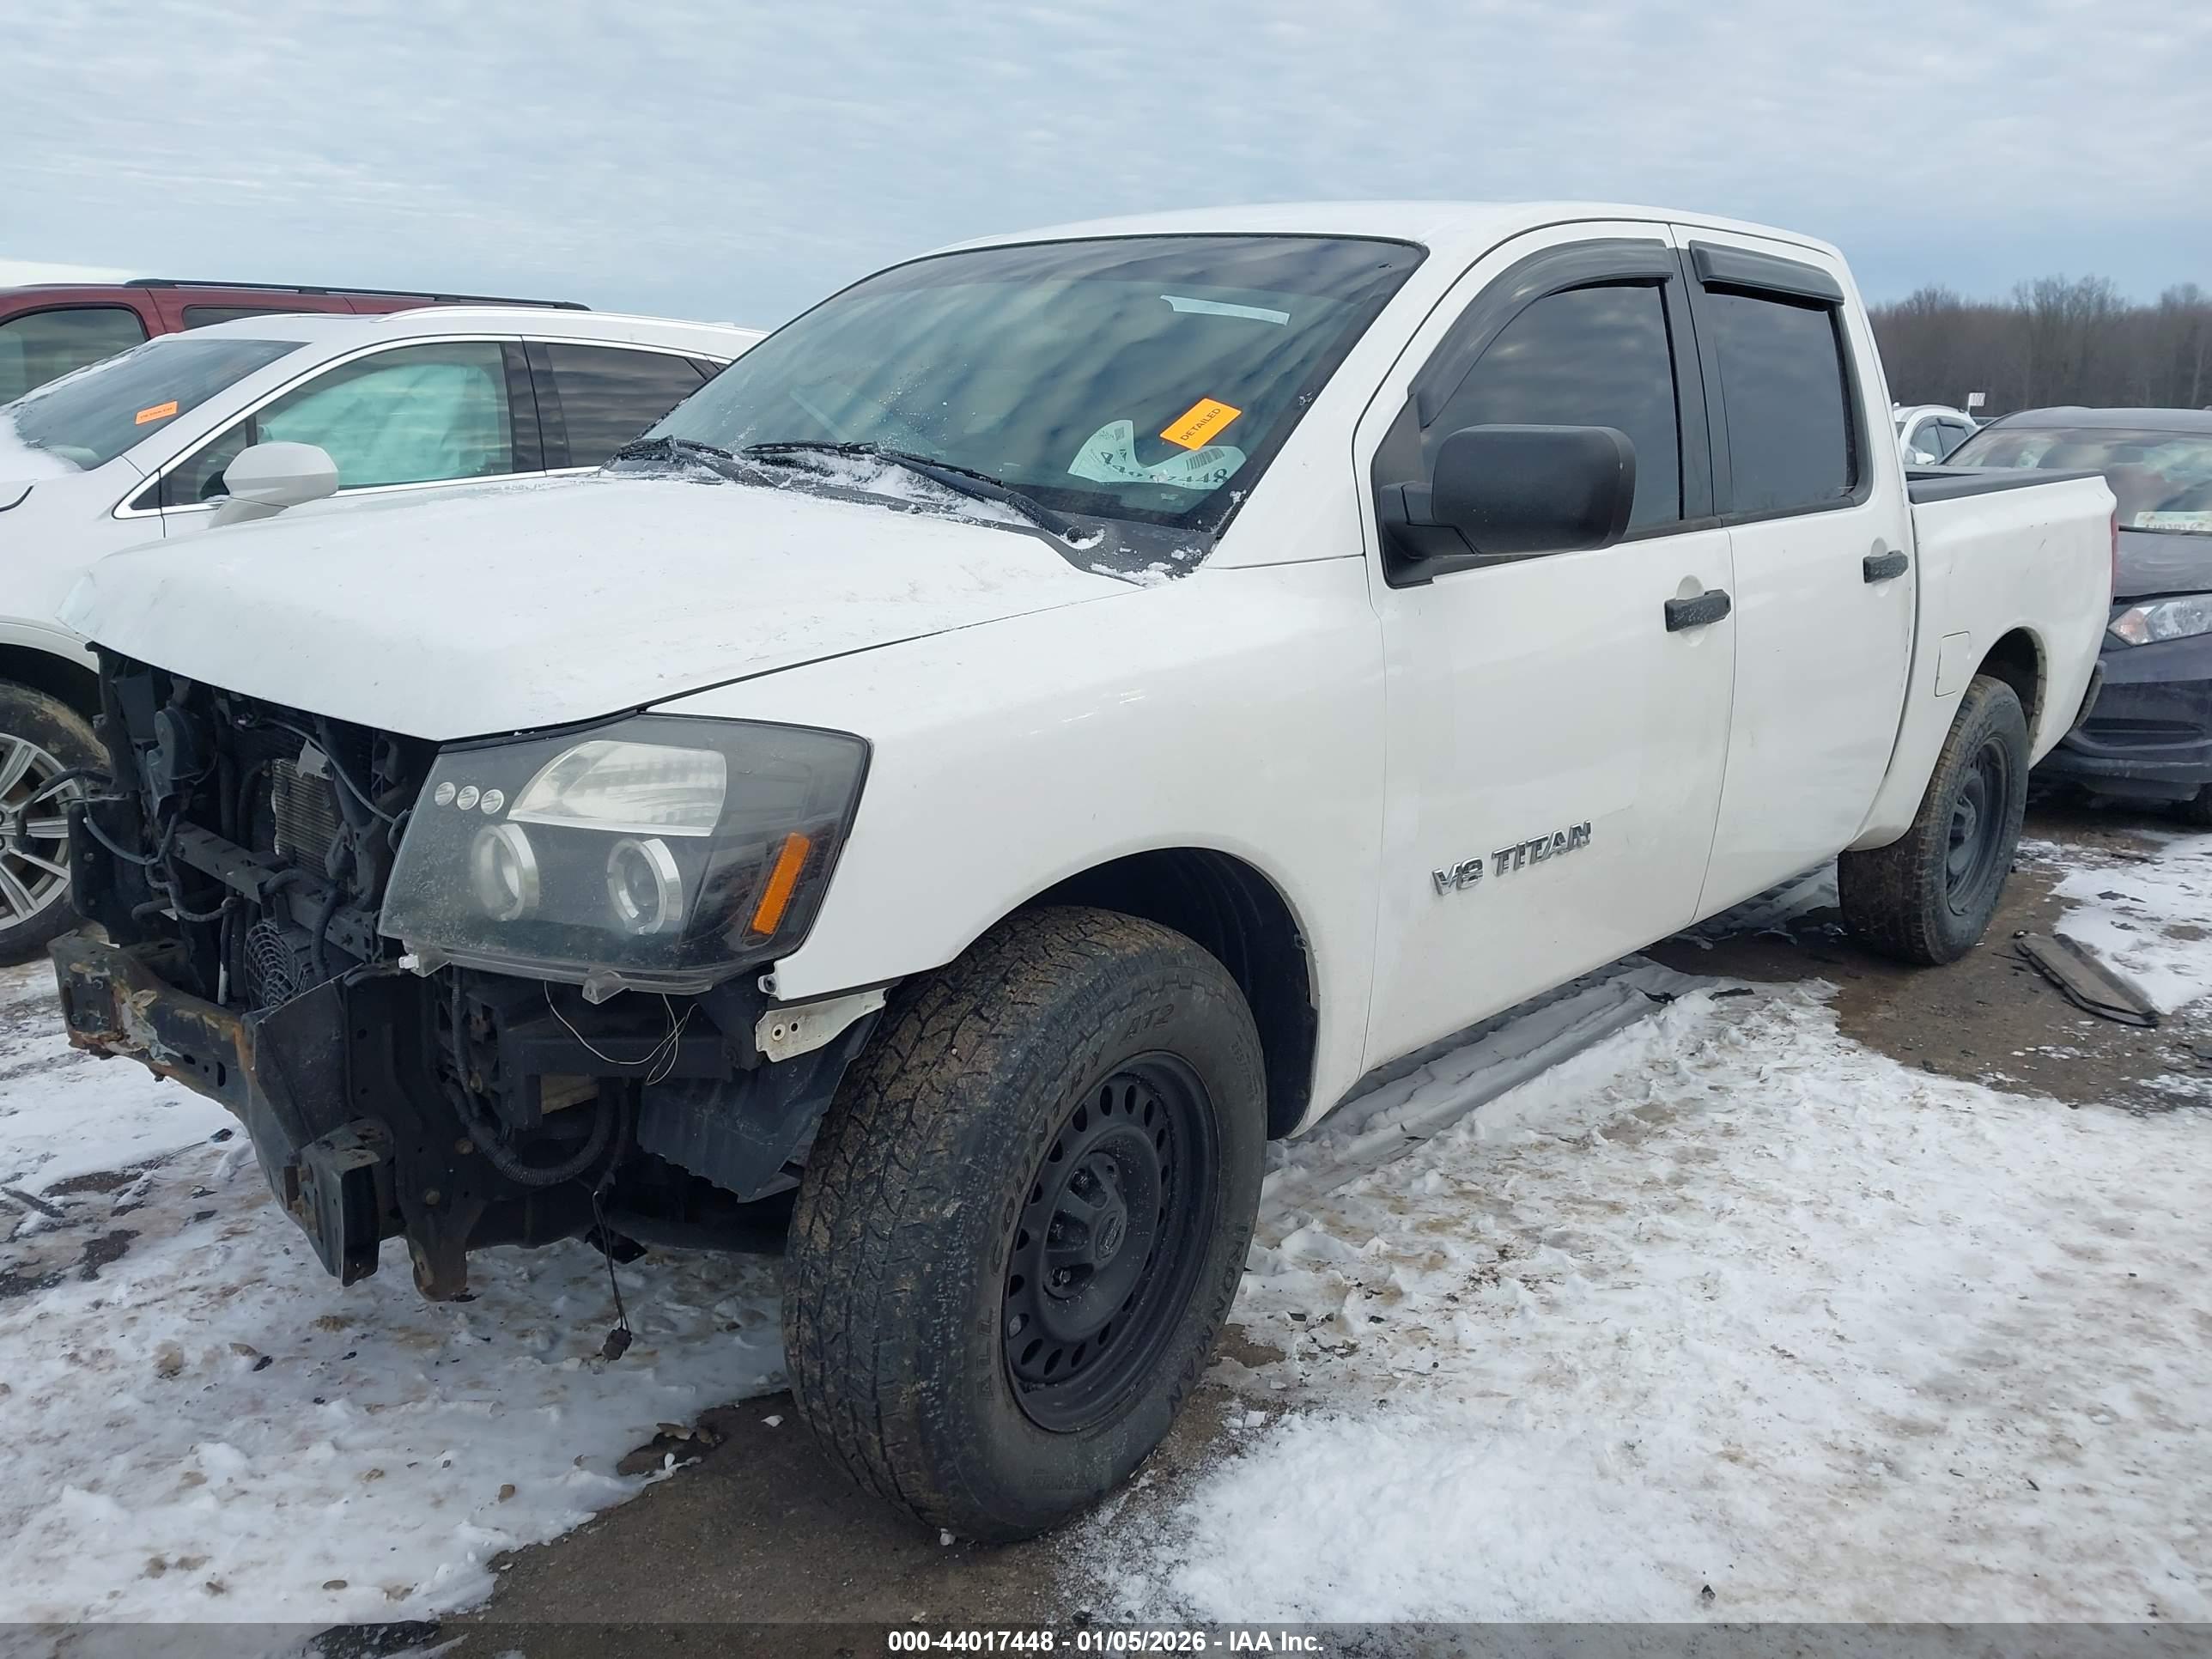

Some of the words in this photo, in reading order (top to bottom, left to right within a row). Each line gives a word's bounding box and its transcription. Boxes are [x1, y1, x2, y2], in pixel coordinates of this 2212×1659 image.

[1180, 407, 1222, 442] DETAILED
[1431, 857, 1484, 896] V8
[1491, 819, 1592, 878] TITAN
[976, 1307, 994, 1399] ALL
[989, 1042, 1104, 1278] COUNTRY
[1169, 1224, 1249, 1413] IRONMAN
